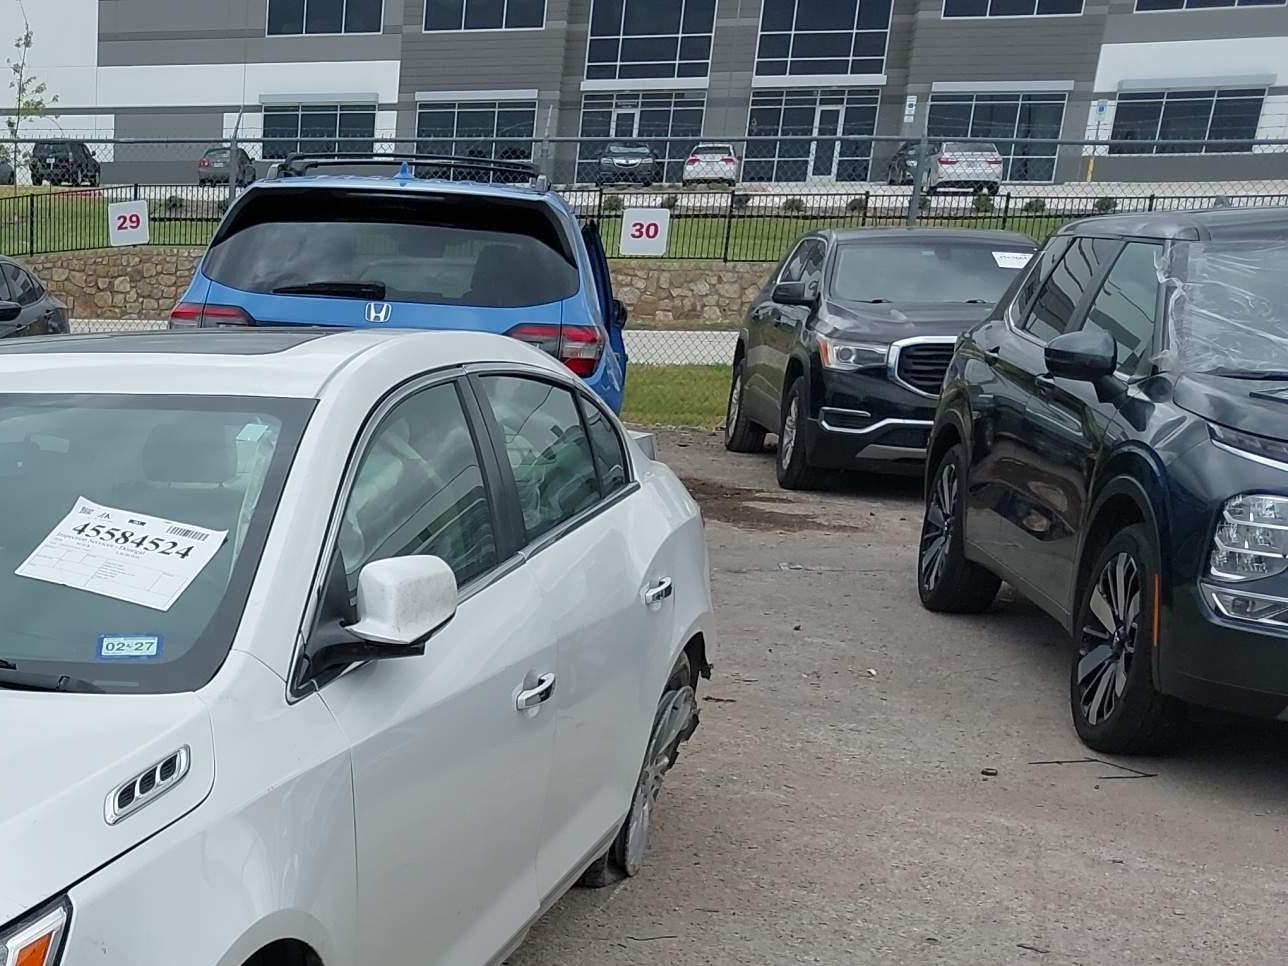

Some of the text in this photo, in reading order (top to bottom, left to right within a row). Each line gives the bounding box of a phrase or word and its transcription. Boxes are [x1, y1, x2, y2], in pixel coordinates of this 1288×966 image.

[116, 213, 140, 231] 29
[630, 222, 659, 239] 30
[71, 521, 195, 560] 45584524
